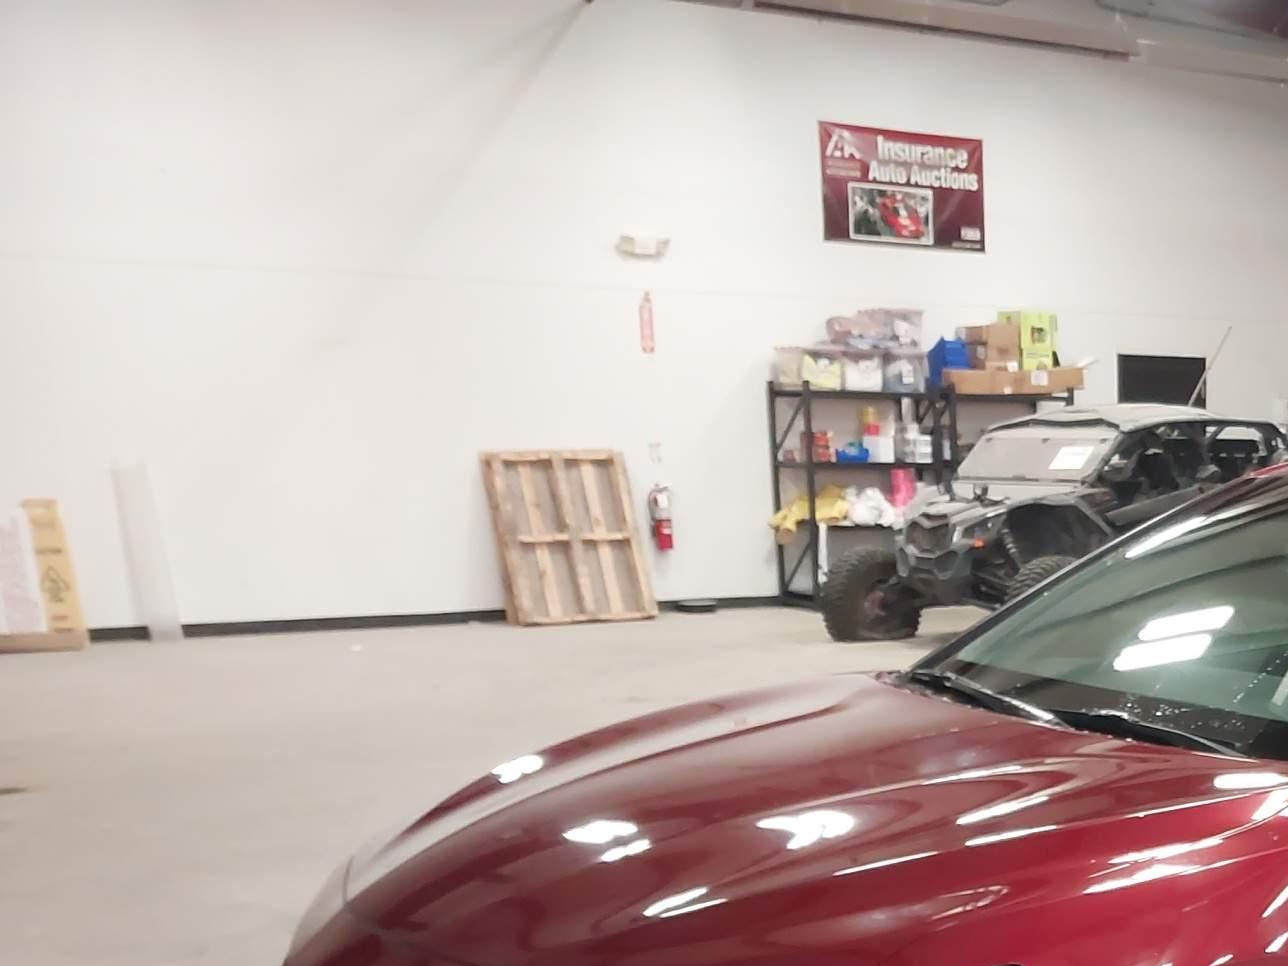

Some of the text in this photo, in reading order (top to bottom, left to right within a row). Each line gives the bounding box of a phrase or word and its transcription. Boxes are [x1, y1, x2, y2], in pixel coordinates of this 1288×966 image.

[877, 134, 968, 169] Insurance
[868, 160, 908, 184] Auto
[909, 165, 979, 191] Auctions
